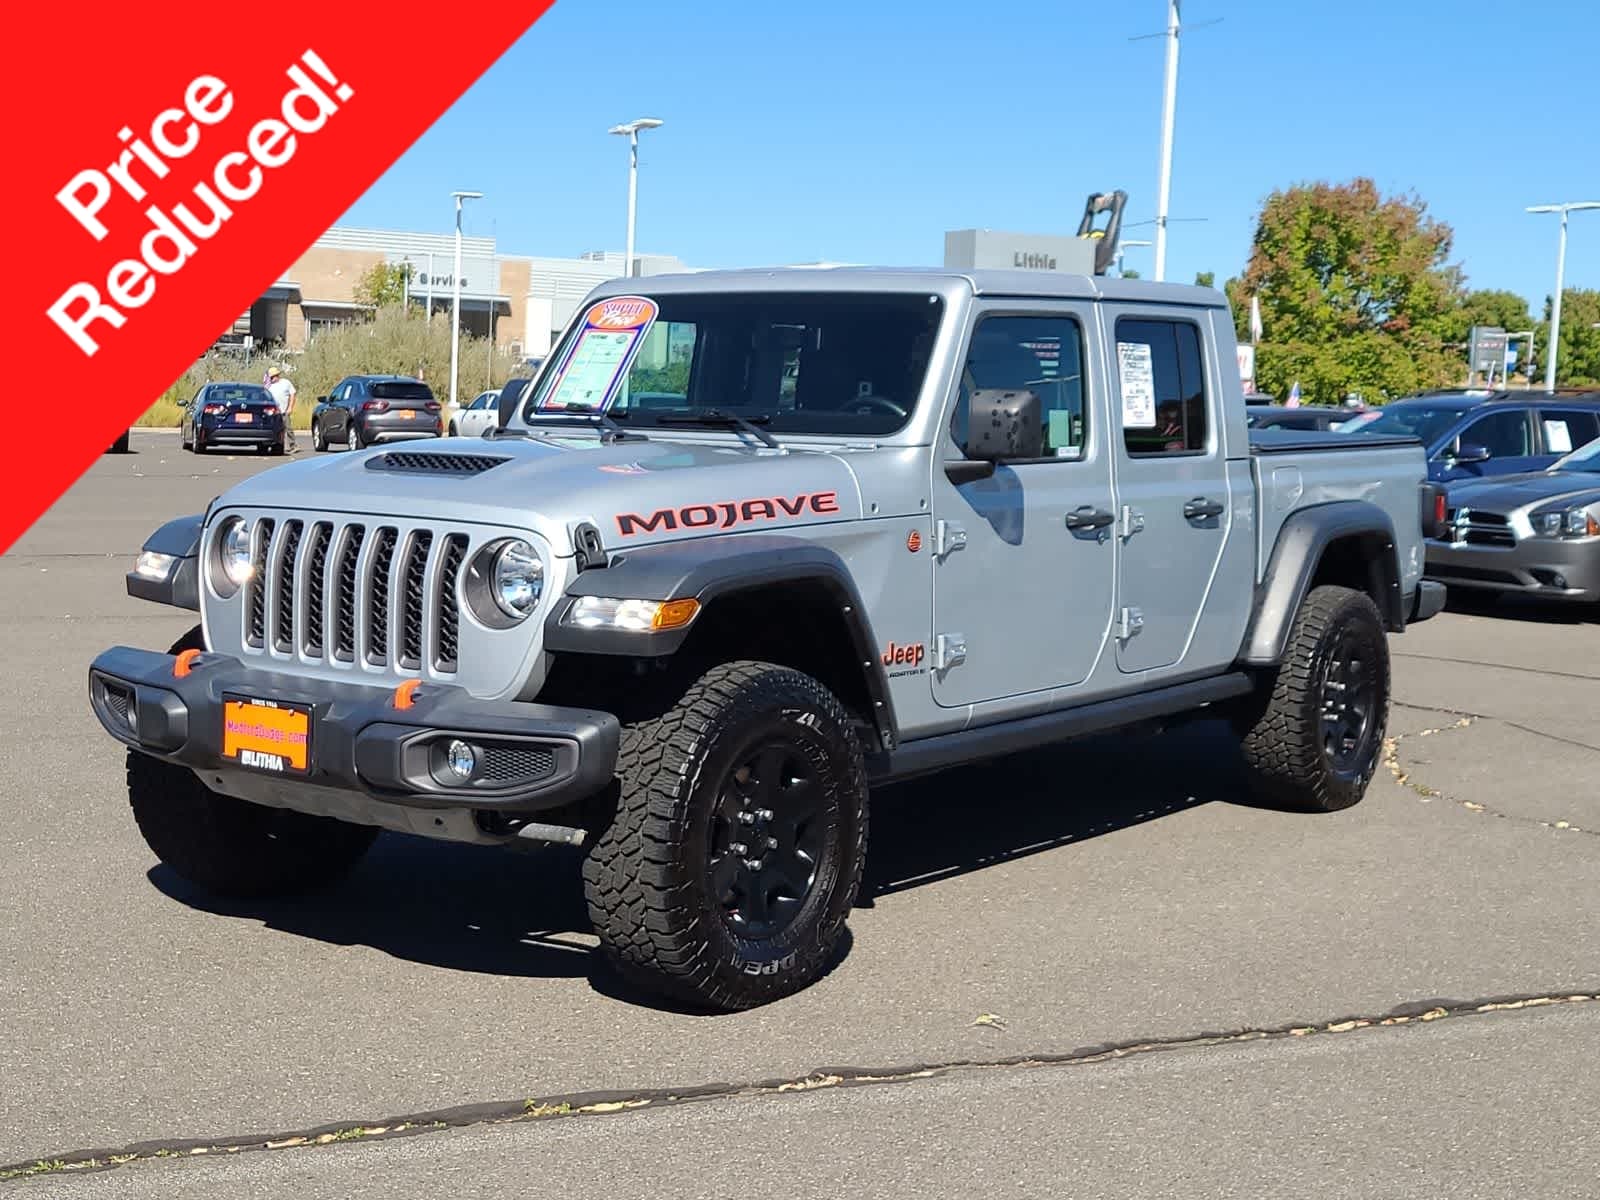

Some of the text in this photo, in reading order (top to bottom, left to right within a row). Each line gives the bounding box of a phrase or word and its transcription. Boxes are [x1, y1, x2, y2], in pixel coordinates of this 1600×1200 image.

[1014, 251, 1057, 270] Lithia
[616, 492, 839, 536] MOJAVE
[881, 641, 925, 667] Jeep
[251, 751, 284, 771] LITHIA
